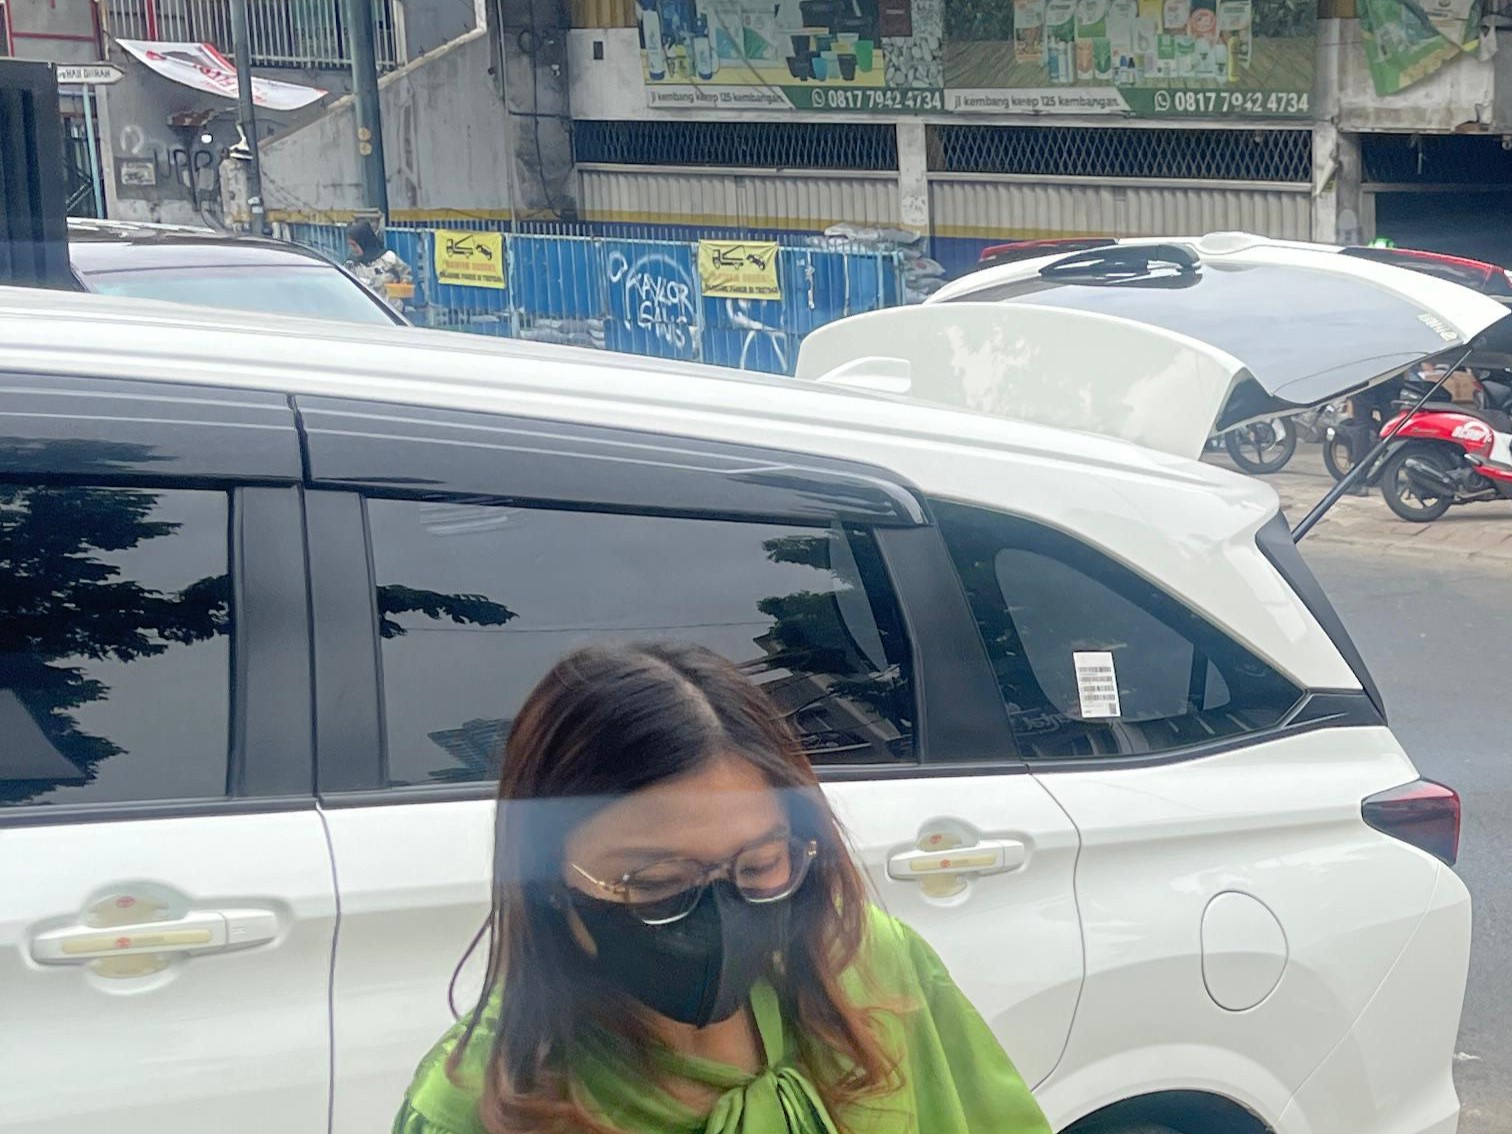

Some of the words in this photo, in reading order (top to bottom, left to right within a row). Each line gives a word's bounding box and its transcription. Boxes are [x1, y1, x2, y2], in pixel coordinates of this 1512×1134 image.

[720, 92, 732, 102] 125
[827, 89, 863, 108] 0817
[866, 90, 902, 109] 7942
[905, 90, 942, 110] 4734
[963, 95, 1010, 108] kembang
[1040, 95, 1056, 107] 125
[1174, 91, 1217, 112] 0817
[1220, 91, 1264, 112] 7942
[1267, 92, 1310, 112] 4734
